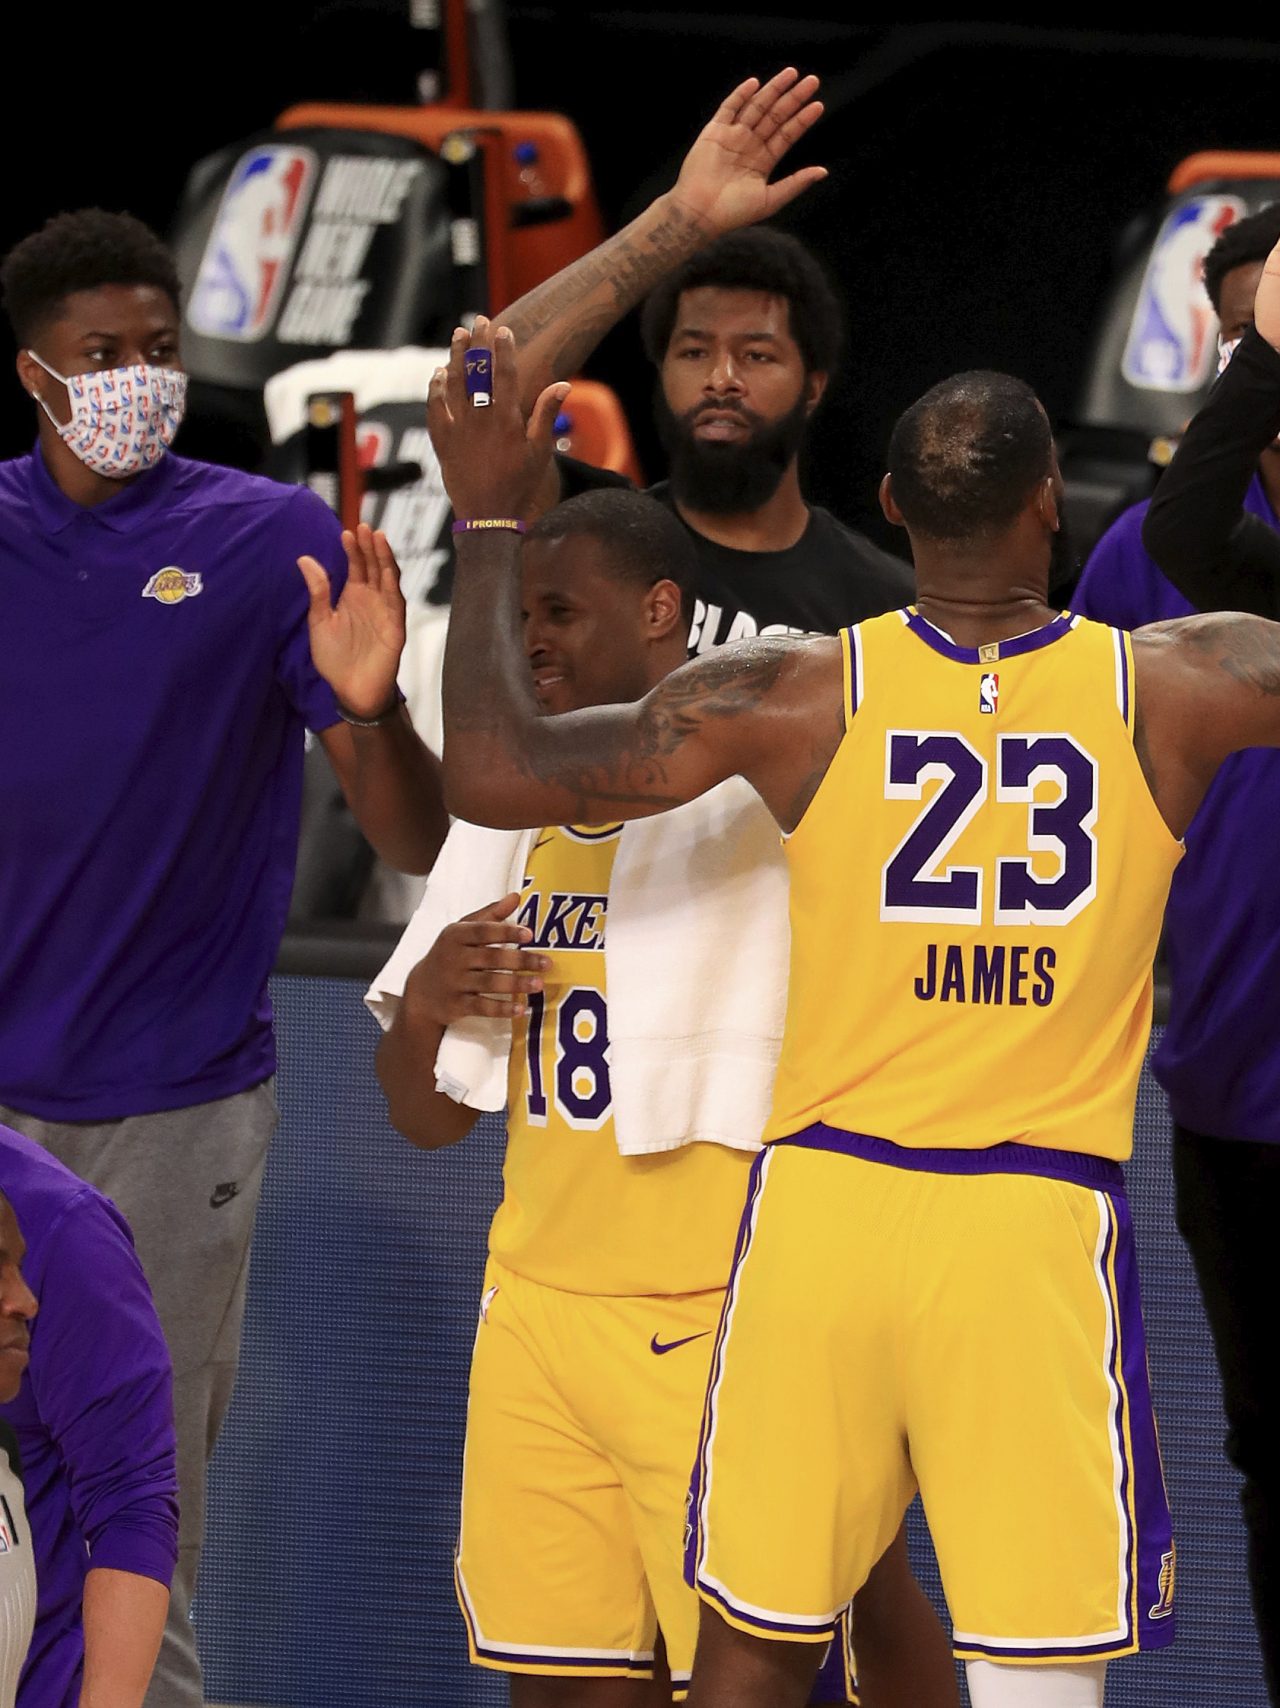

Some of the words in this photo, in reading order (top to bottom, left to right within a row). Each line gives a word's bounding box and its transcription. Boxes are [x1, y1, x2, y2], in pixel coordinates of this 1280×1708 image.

[473, 519, 518, 529] PROMISE
[880, 729, 1099, 926] 23
[914, 944, 1056, 1007] JAMES
[525, 985, 613, 1131] 18
